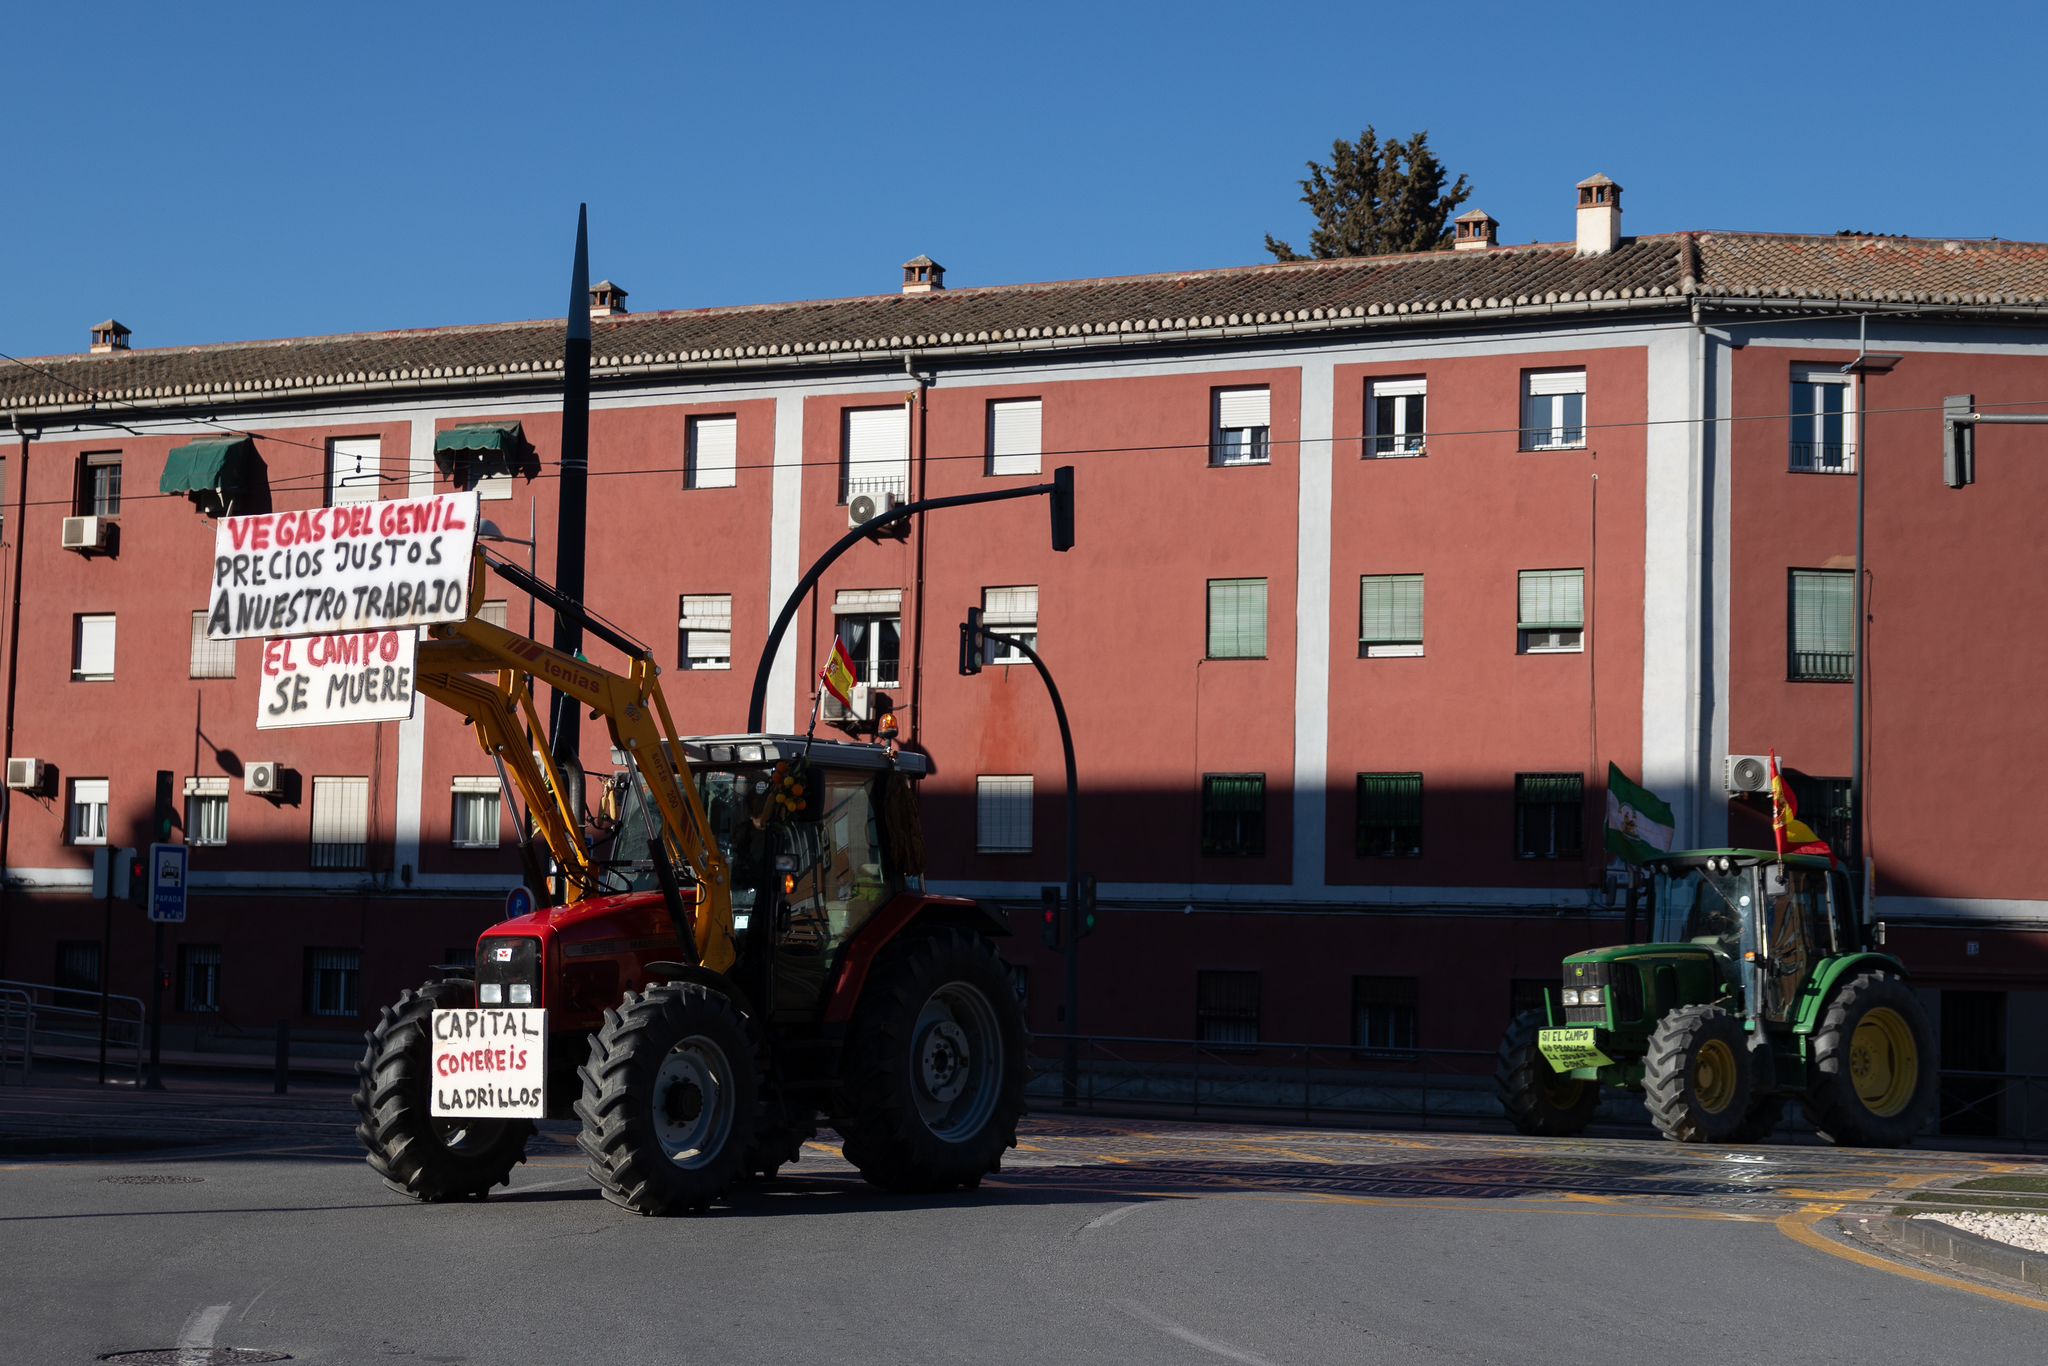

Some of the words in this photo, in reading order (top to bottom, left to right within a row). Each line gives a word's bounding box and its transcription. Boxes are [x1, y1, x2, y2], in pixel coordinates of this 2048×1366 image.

[228, 508, 329, 550] VEGAS
[331, 505, 373, 539] DEL
[334, 537, 443, 572] JUSTOS
[207, 589, 231, 636] A
[236, 587, 347, 633] NUESTRO
[353, 579, 462, 620] TRABAJO
[264, 639, 297, 676] EL
[307, 631, 399, 668] CAMPO
[268, 675, 310, 715] SE
[326, 665, 410, 709] MUERE
[155, 894, 182, 904] PARADA
[1542, 1031, 1550, 1041] SI
[1553, 1031, 1562, 1041] EL
[1565, 1030, 1588, 1041] CAMPO
